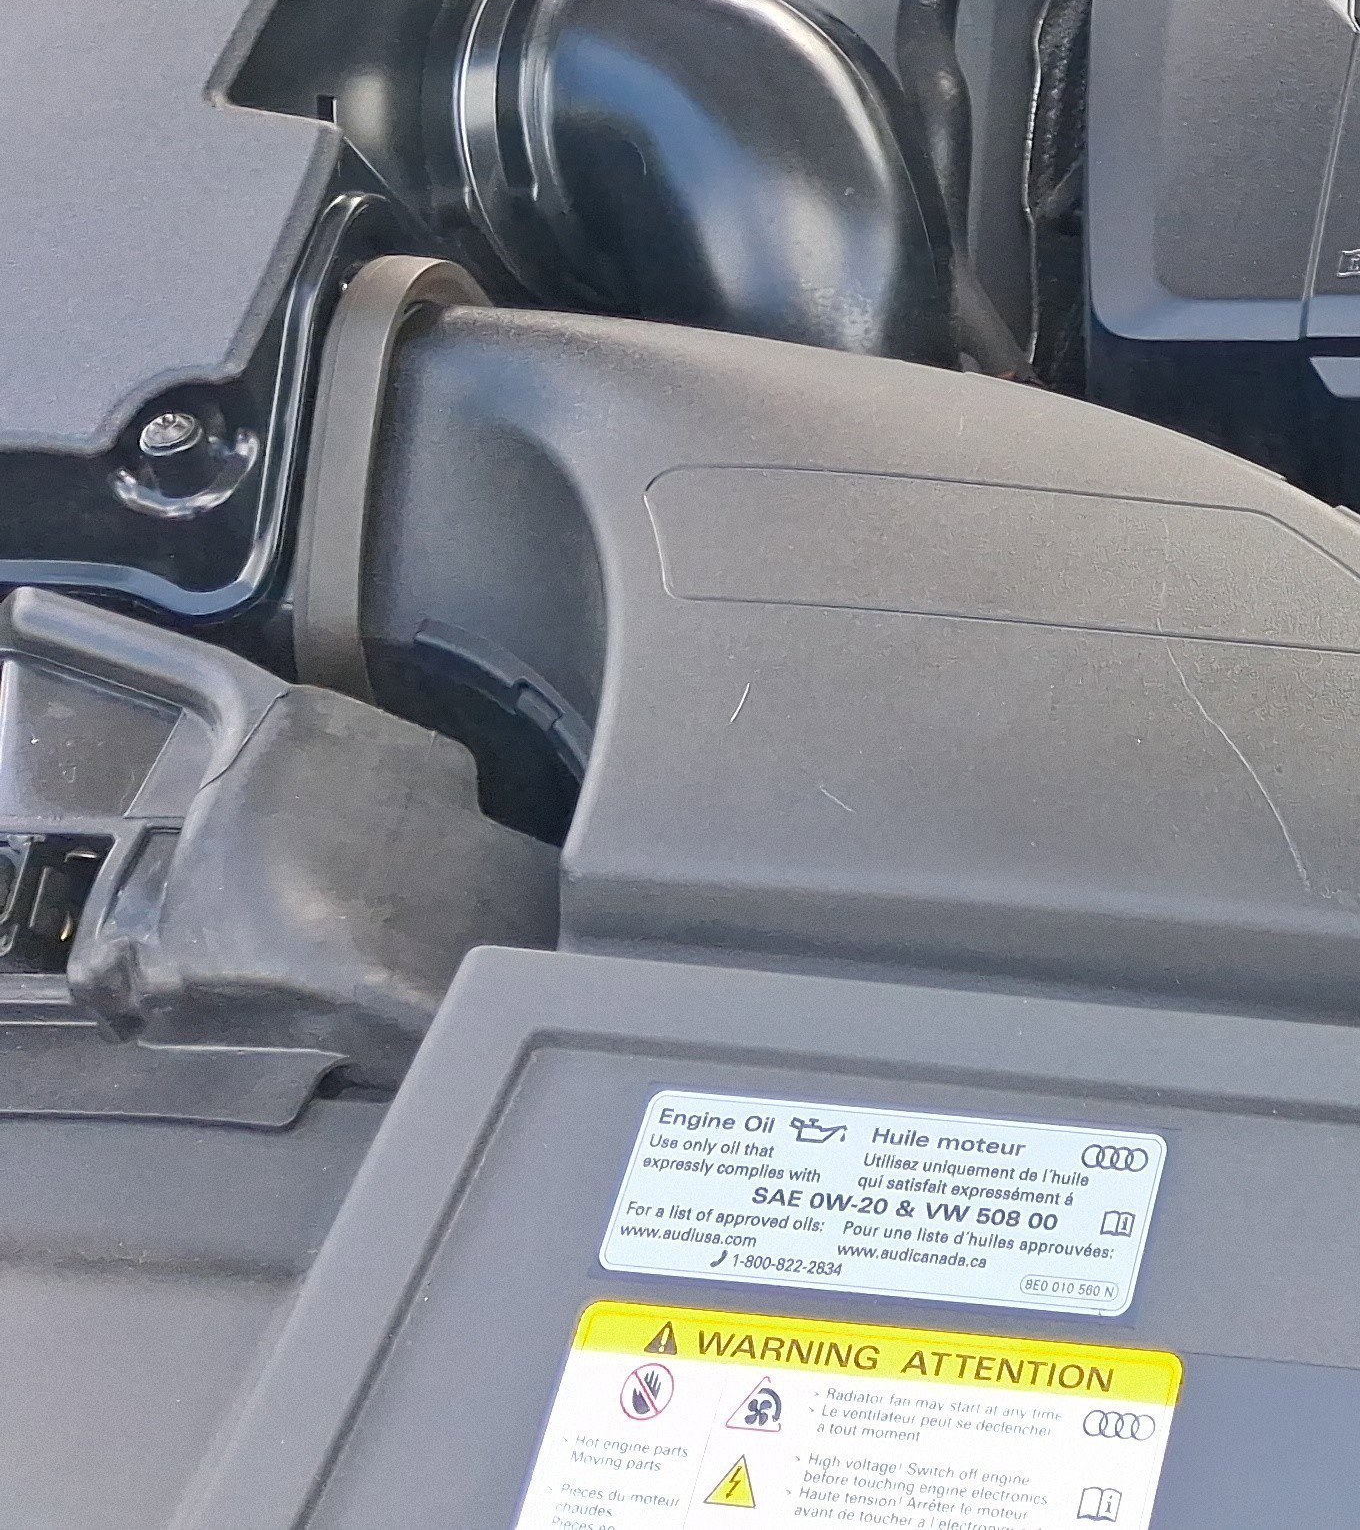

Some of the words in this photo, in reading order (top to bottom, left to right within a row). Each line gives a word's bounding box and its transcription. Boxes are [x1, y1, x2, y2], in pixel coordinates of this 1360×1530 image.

[658, 1107, 736, 1131] Engine
[744, 1115, 776, 1134] Oil
[649, 1133, 679, 1149] Use
[683, 1138, 717, 1156] only
[720, 1141, 741, 1154] oil
[744, 1144, 775, 1159] that
[871, 1127, 930, 1148] Huile
[936, 1134, 1027, 1157] moteur
[643, 1157, 714, 1177] expressly
[716, 1163, 785, 1180] complies
[789, 1168, 821, 1183] with
[863, 1152, 918, 1171] Utilisez
[922, 1160, 1016, 1184] uniquement
[1018, 1167, 1038, 1182] de
[857, 1173, 884, 1190] qui
[886, 1177, 948, 1195] satisfait
[626, 1200, 651, 1216] For
[655, 1206, 664, 1218] a
[669, 1205, 692, 1221] list
[695, 1208, 713, 1222] of
[715, 1211, 789, 1229] approved
[792, 1216, 826, 1233] oils:
[751, 1186, 804, 1208] SAE
[809, 1191, 889, 1216] 0W-20
[895, 1200, 916, 1218] &
[925, 1202, 971, 1222] VW
[976, 1207, 1021, 1228] 508
[1028, 1212, 1059, 1231] 00
[620, 1225, 757, 1248] www.audiusa.com
[842, 1220, 879, 1238] Pour
[883, 1227, 912, 1241] une
[917, 1227, 949, 1244] liste
[837, 1243, 988, 1269] www.audicanada.ca
[1104, 1286, 1115, 1298] N
[697, 1329, 880, 1370] WARNING
[901, 1349, 1115, 1393] ATTENTION
[827, 1387, 883, 1405] Radiator
[889, 1394, 911, 1407] fan
[916, 1398, 944, 1412] may
[949, 1400, 980, 1415] start
[1002, 1406, 1025, 1420] any
[821, 1404, 838, 1418] Le
[842, 1408, 917, 1426] ventilateur
[920, 1415, 953, 1430] peut
[956, 1419, 973, 1431] se
[829, 1423, 857, 1436] tout
[861, 1426, 921, 1442] moment
[576, 1434, 599, 1448] Hot
[603, 1438, 650, 1454] engine
[653, 1443, 688, 1458] parts
[571, 1450, 623, 1469] Moving
[626, 1457, 662, 1472] parts
[808, 1453, 841, 1471] High
[906, 1462, 954, 1479] Switch
[959, 1468, 978, 1481] off
[981, 1472, 1031, 1488] engine
[608, 1490, 625, 1502] du
[630, 1494, 680, 1508] moteur
[803, 1470, 849, 1486] before
[852, 1476, 915, 1496] touching
[919, 1483, 968, 1499] engine
[971, 1486, 1049, 1506] electronics
[555, 1501, 613, 1517] chaudes
[794, 1506, 833, 1520] avant
[837, 1508, 855, 1521] de
[859, 1511, 913, 1527] toucher
[798, 1486, 841, 1503] Haute
[960, 1503, 973, 1516] le
[976, 1507, 1029, 1521] moteur
